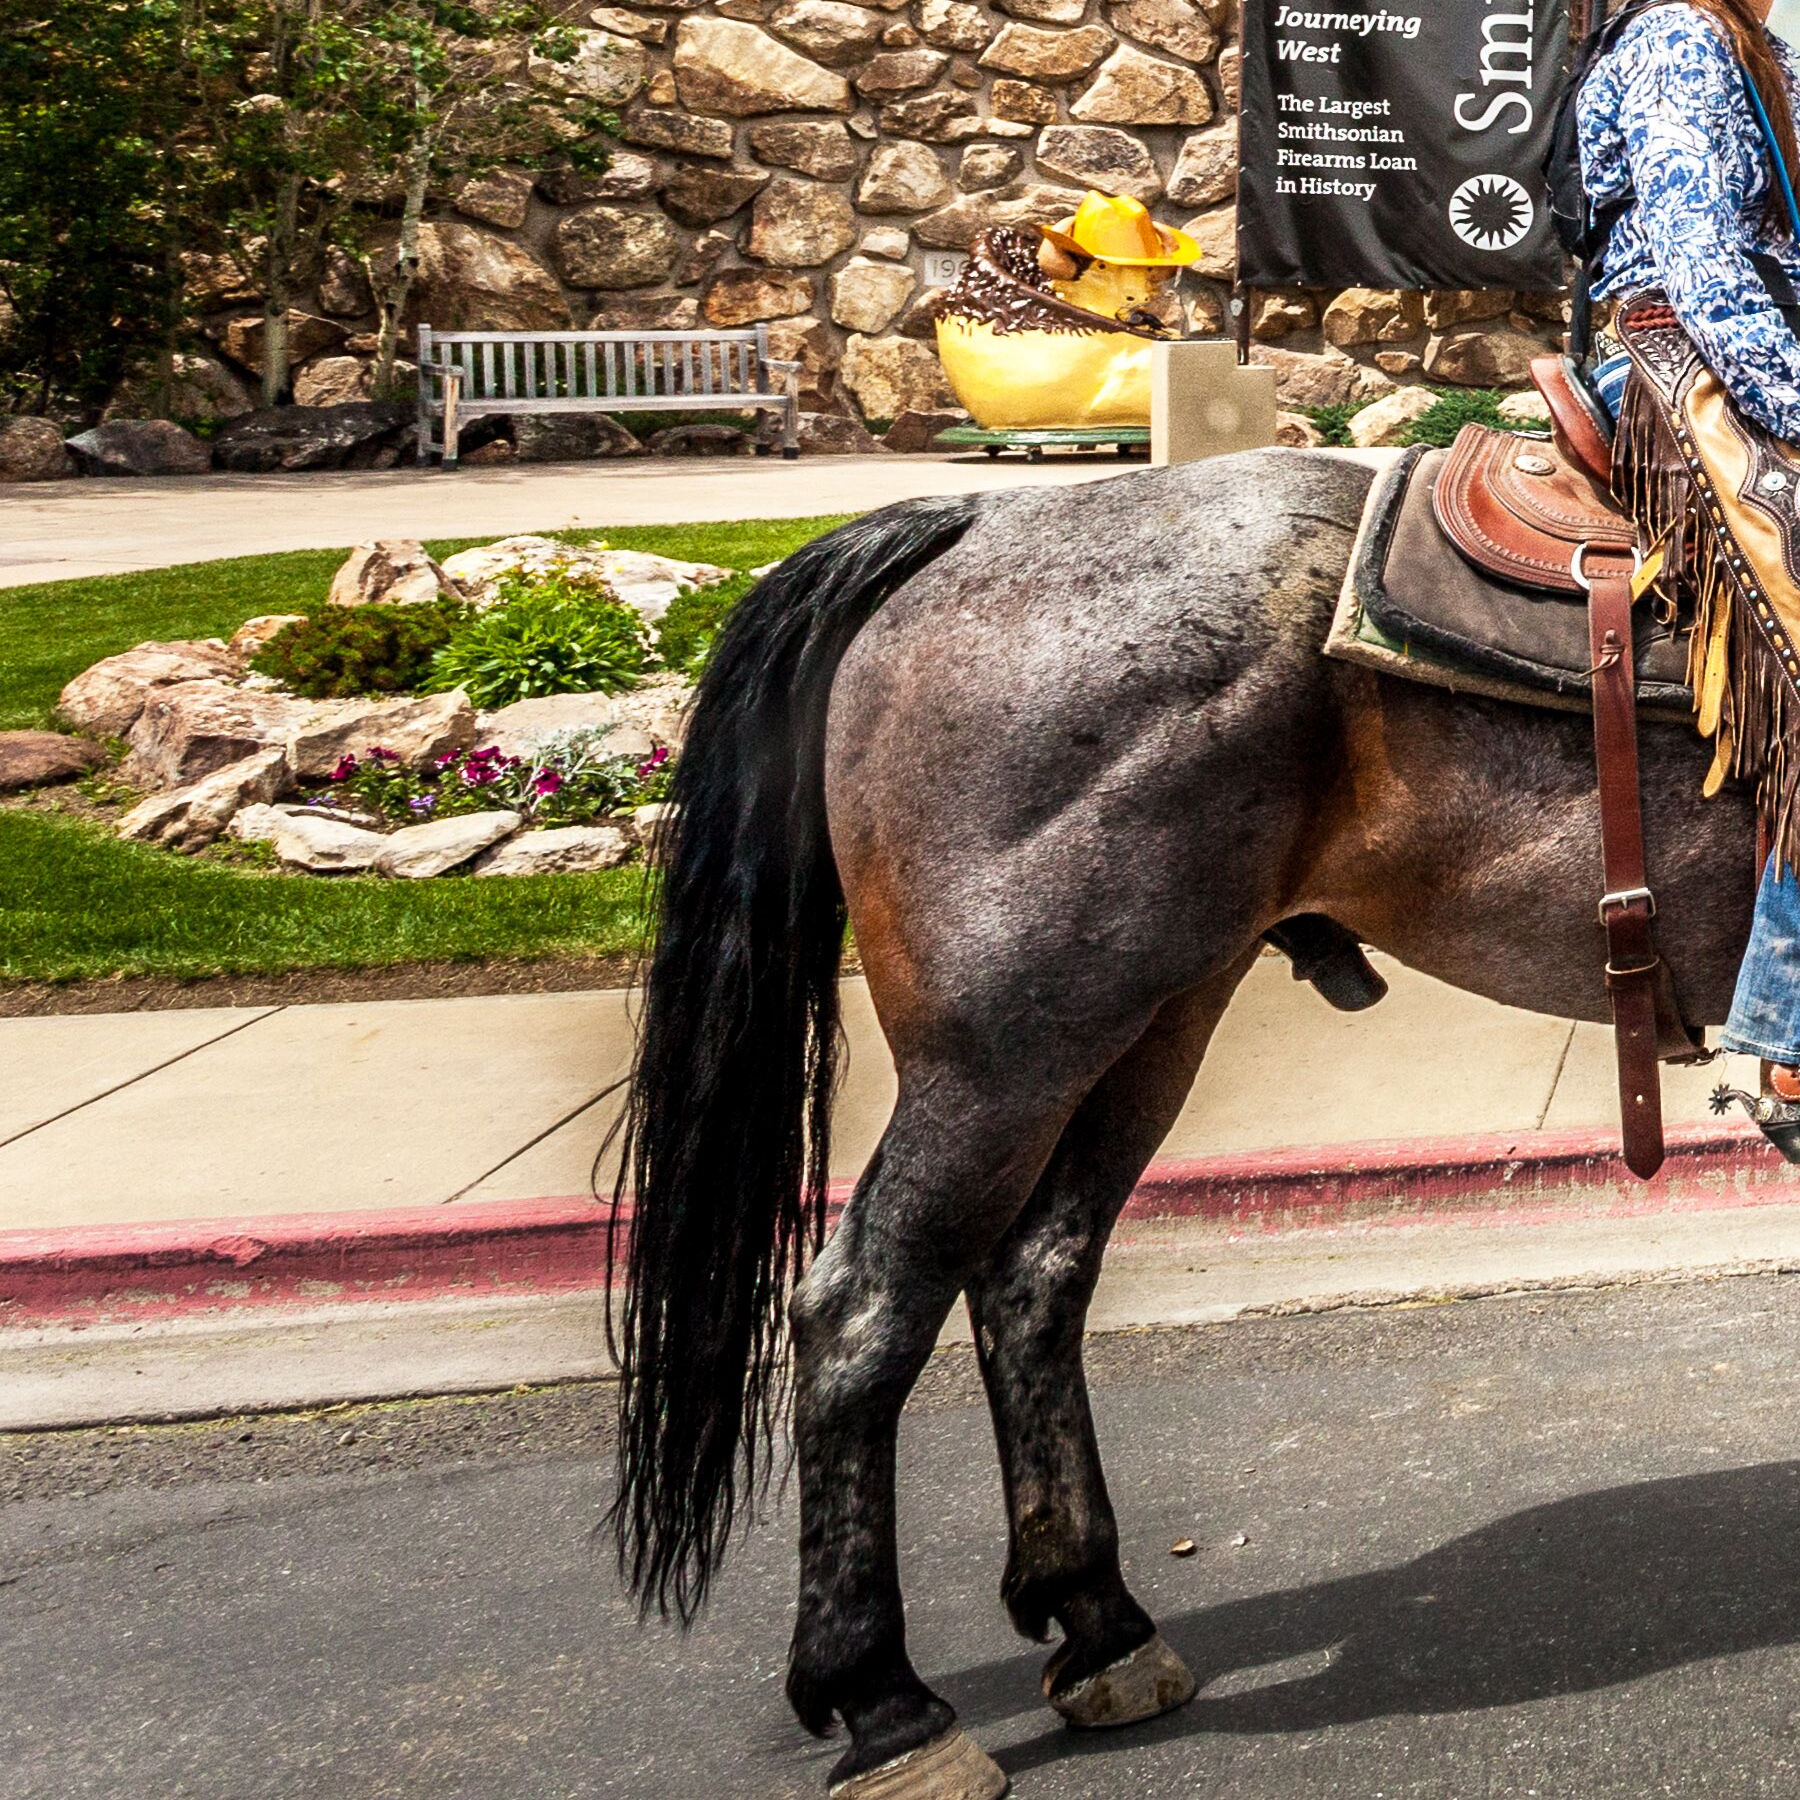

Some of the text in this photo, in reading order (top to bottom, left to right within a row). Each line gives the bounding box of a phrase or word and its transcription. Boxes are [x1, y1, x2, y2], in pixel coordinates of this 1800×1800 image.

[1274, 5, 1422, 40] Journeying
[1277, 39, 1342, 64] West
[1277, 93, 1391, 120] The Largest
[1278, 121, 1405, 143] Smithsonian
[1276, 148, 1418, 171] Firearms Loan
[1275, 175, 1377, 202] in History
